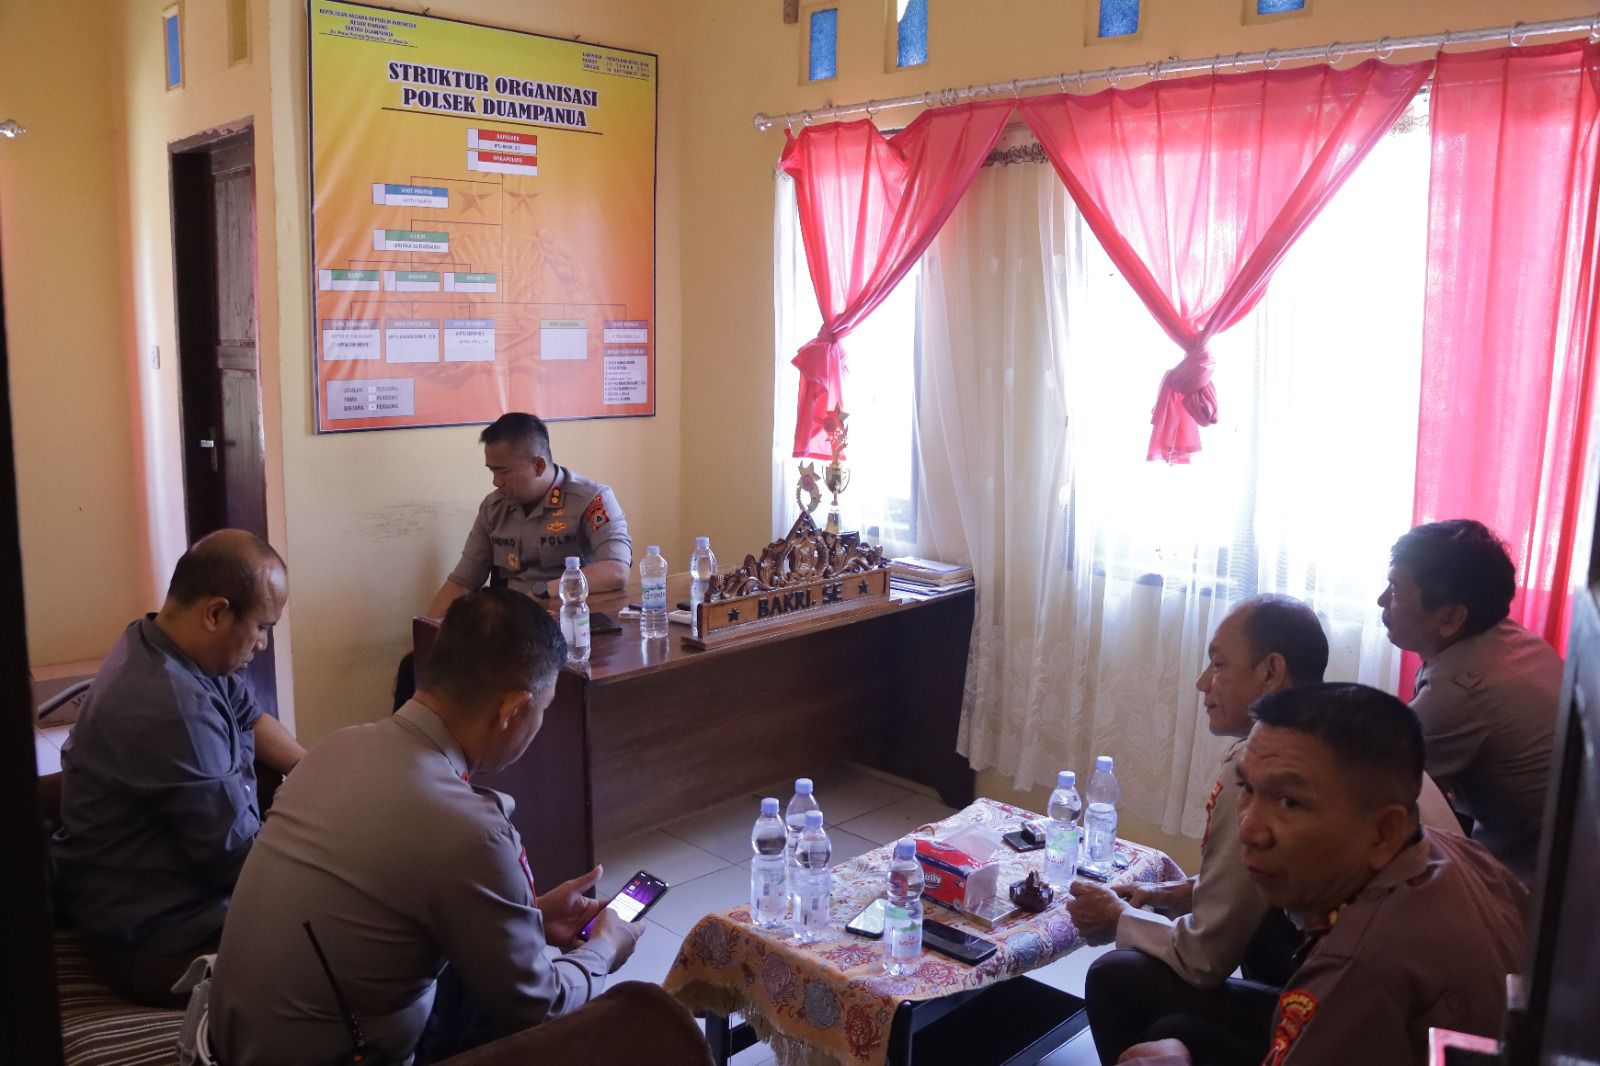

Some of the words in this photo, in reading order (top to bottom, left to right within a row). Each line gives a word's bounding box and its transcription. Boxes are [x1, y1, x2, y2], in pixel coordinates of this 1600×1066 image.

[388, 62, 488, 91] STRUKTUR
[495, 77, 598, 106] ORGANISASI
[403, 87, 476, 112] POLSEK
[482, 98, 587, 126] DUAMPANUA
[822, 582, 844, 604] SE
[924, 873, 942, 884] olly
